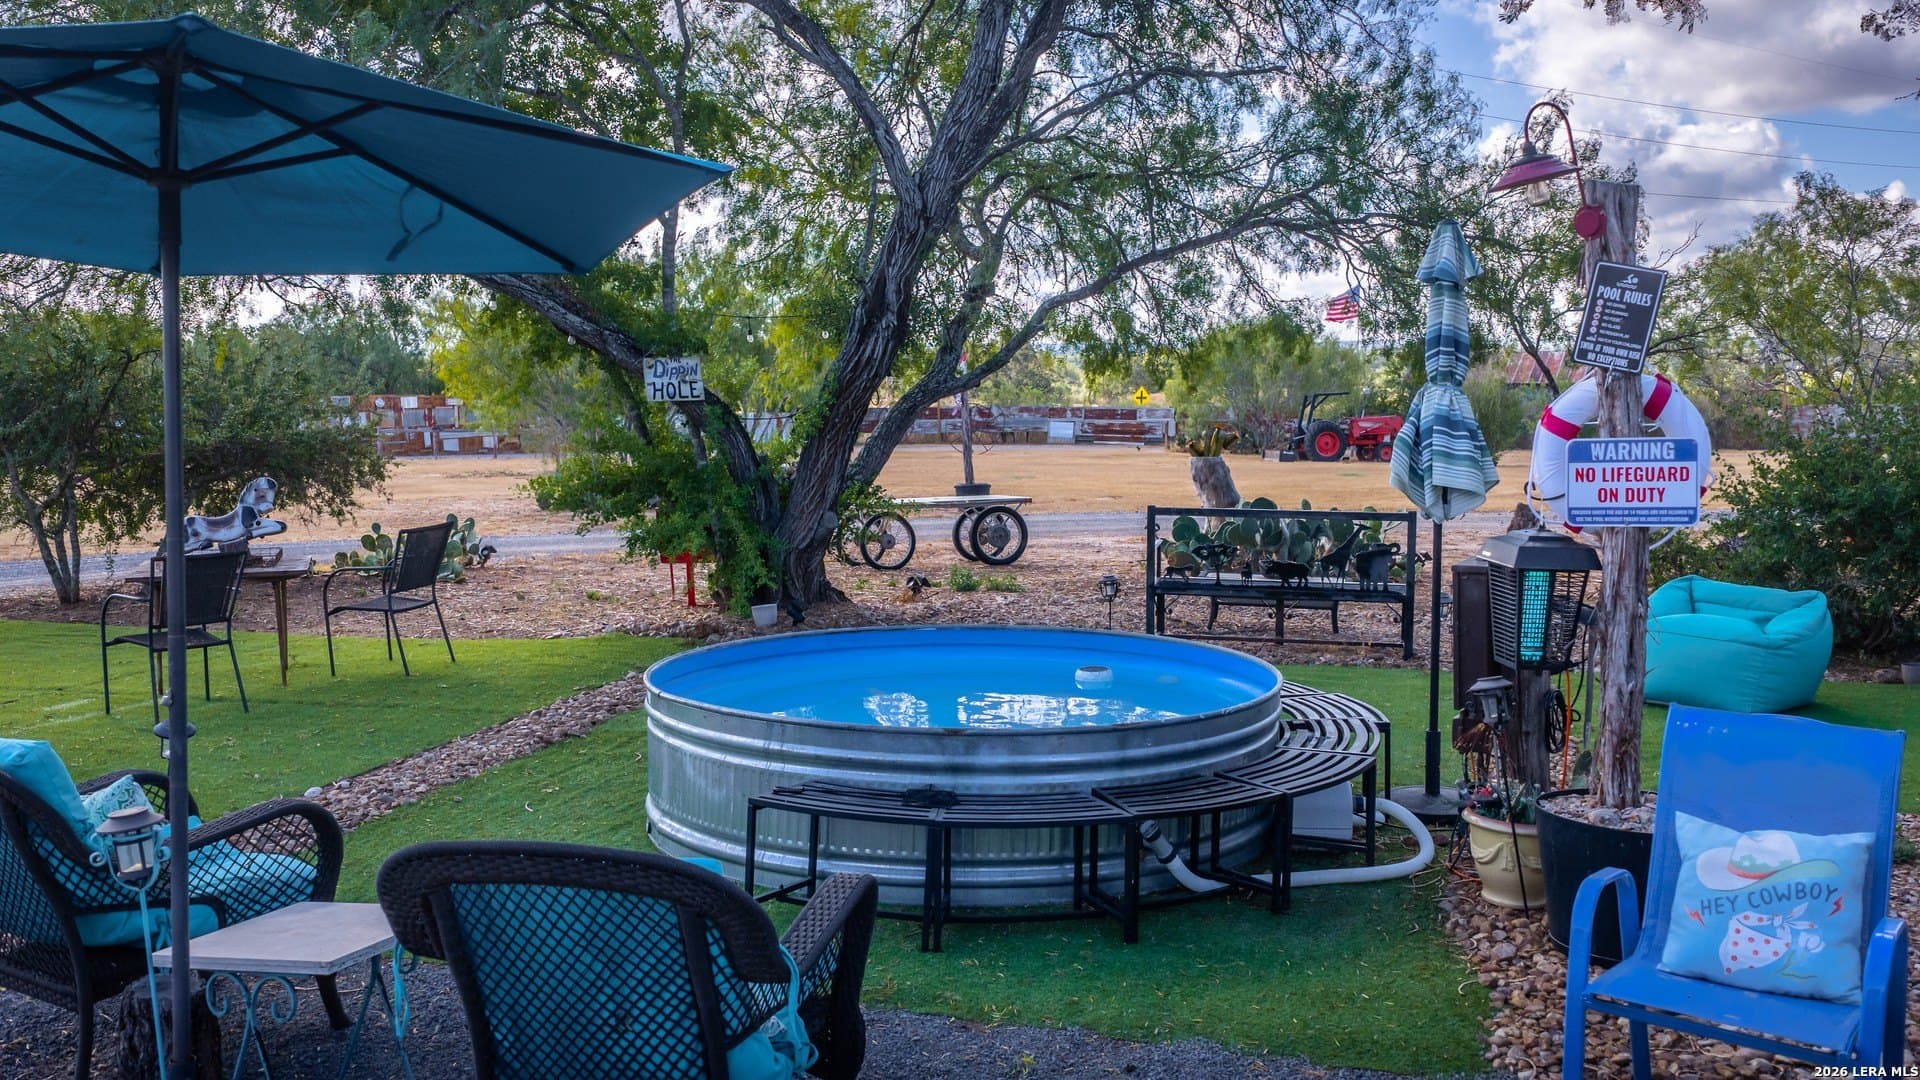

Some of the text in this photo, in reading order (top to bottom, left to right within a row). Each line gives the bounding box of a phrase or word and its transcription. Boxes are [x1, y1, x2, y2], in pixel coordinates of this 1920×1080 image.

[1597, 285, 1653, 307] POOL RULES
[653, 380, 701, 400] HOLE
[1590, 442, 1675, 460] WARNING
[1575, 466, 1690, 482] NO LIFEGUARD
[1597, 487, 1666, 503] ON DUTY
[1700, 881, 1839, 917] HEY COWBOY
